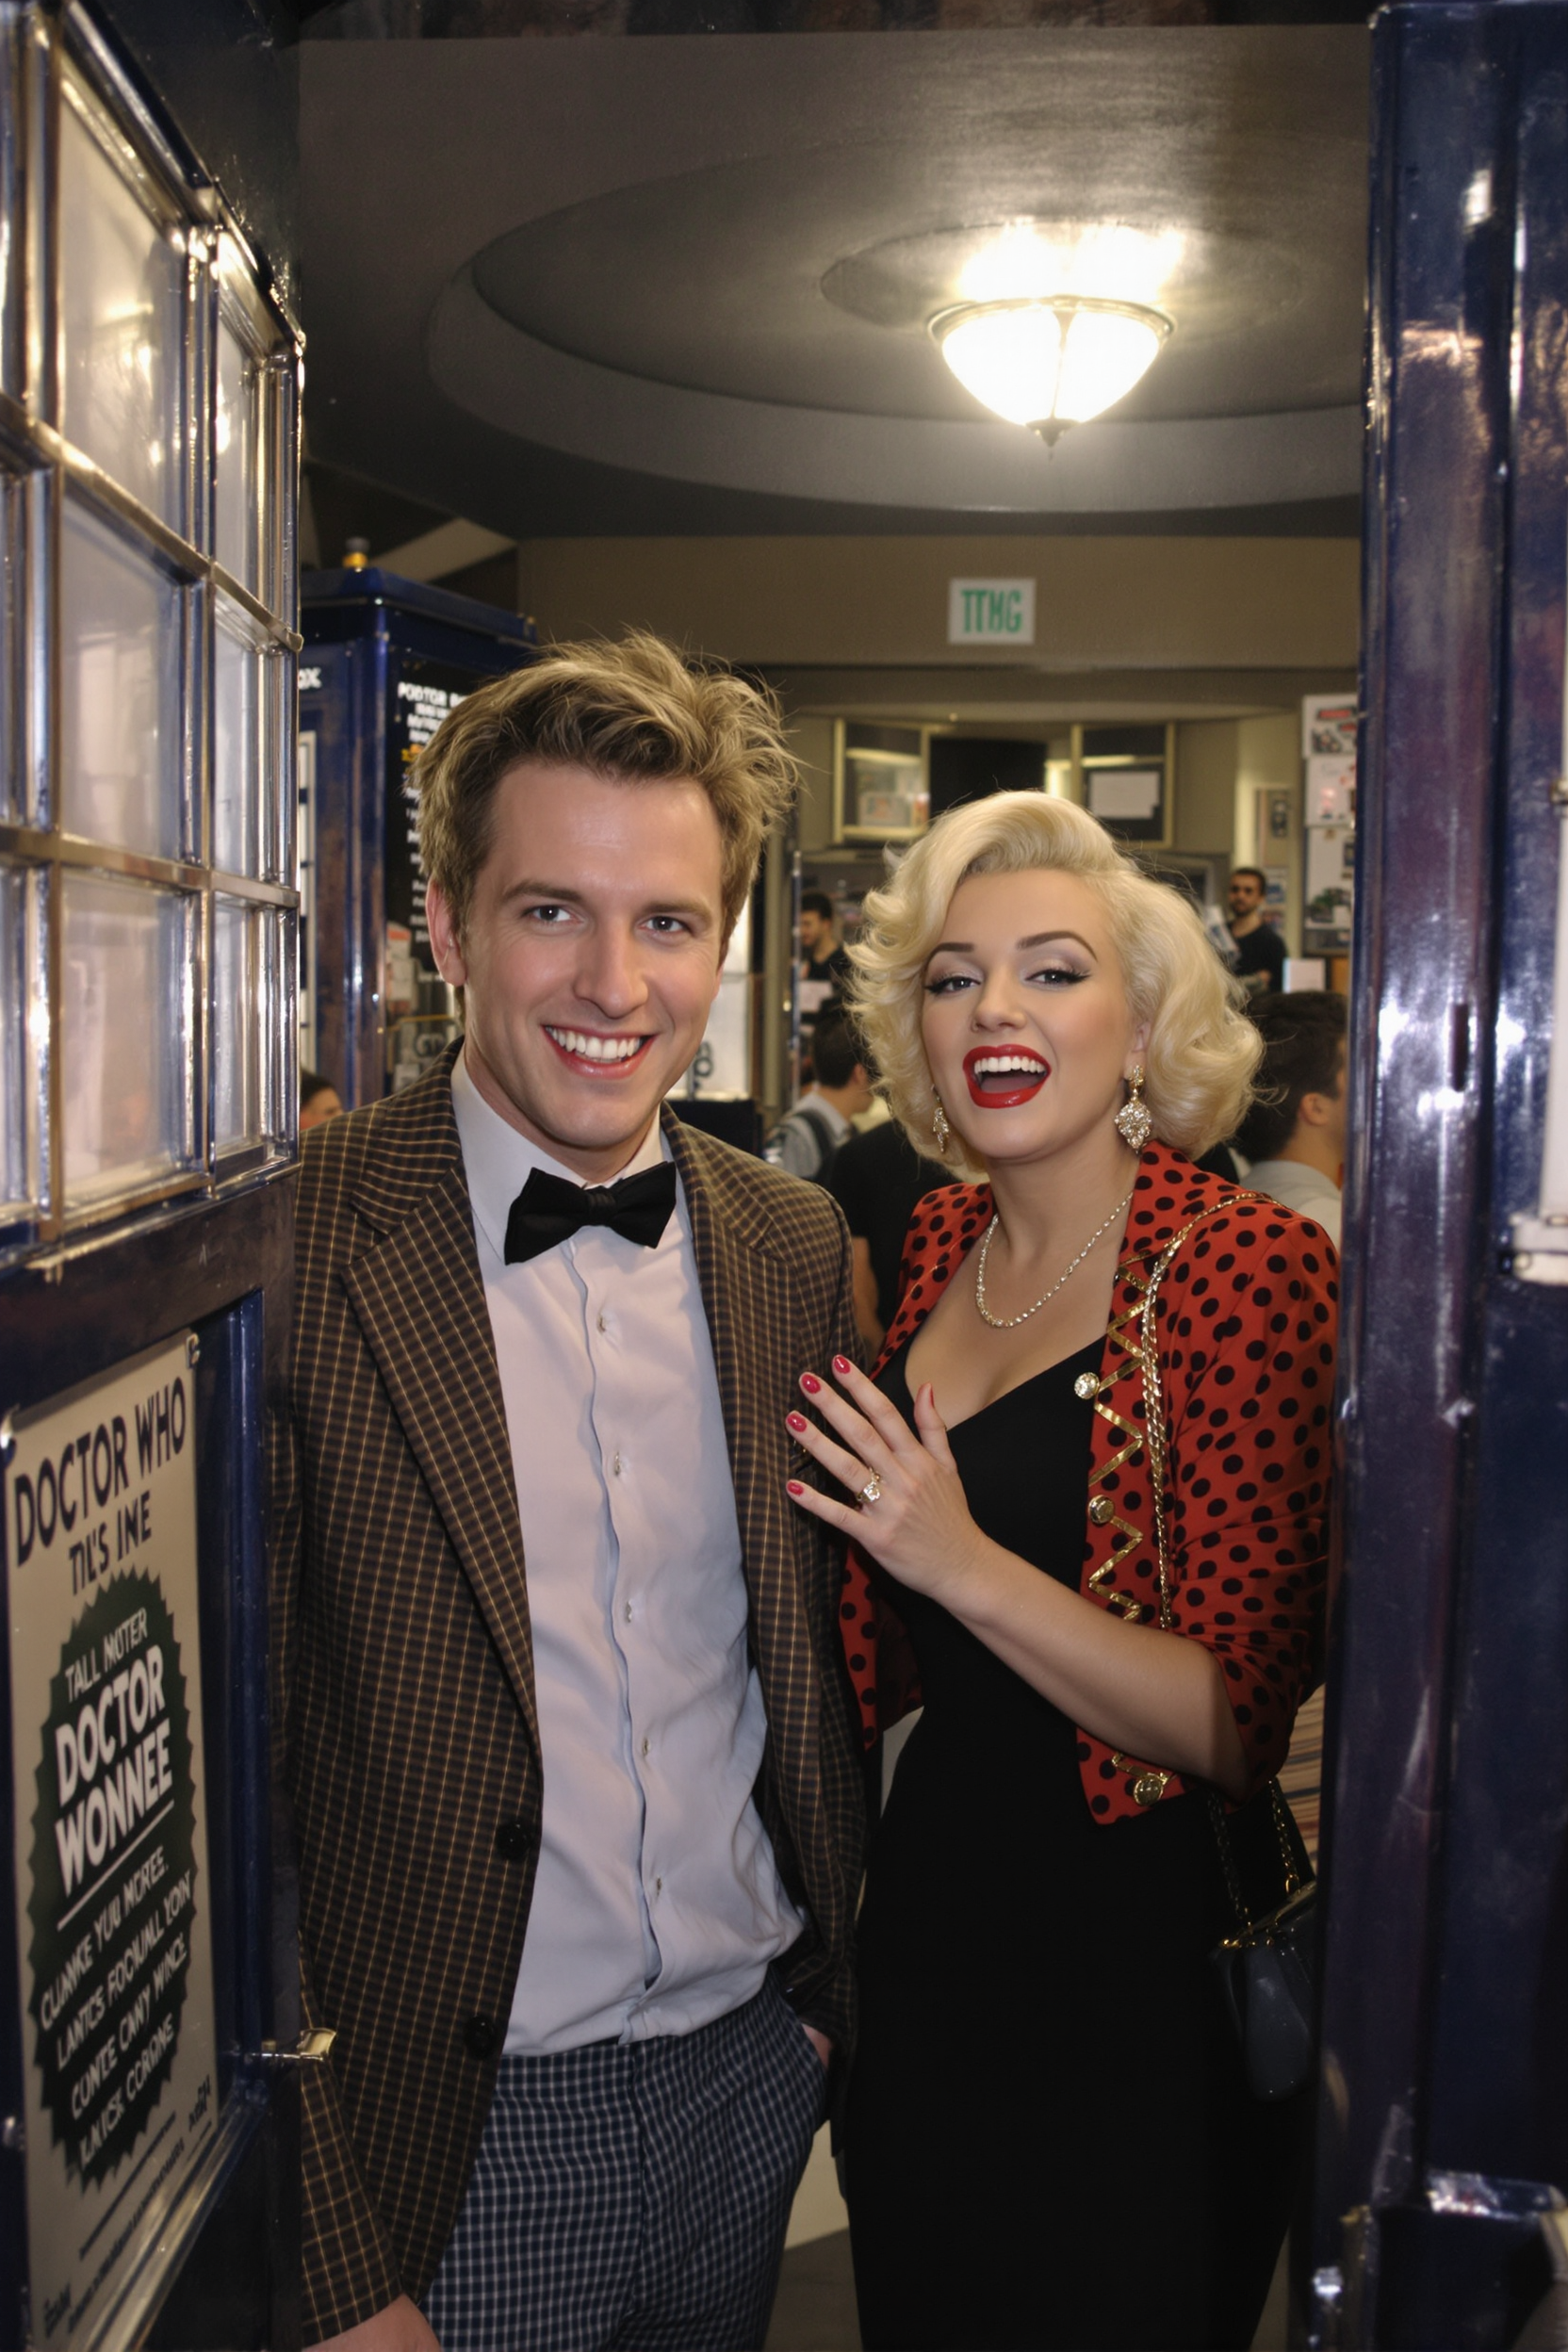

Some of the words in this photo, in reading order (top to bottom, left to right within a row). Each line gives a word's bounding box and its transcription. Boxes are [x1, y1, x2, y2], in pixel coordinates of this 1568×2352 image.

[14, 1415, 129, 1568] DOCTOR
[135, 1377, 187, 1479] WHO
[56, 1644, 166, 1807] DOCTOR
[65, 1648, 101, 1703] TALL
[55, 1718, 172, 1898] WONNEE
